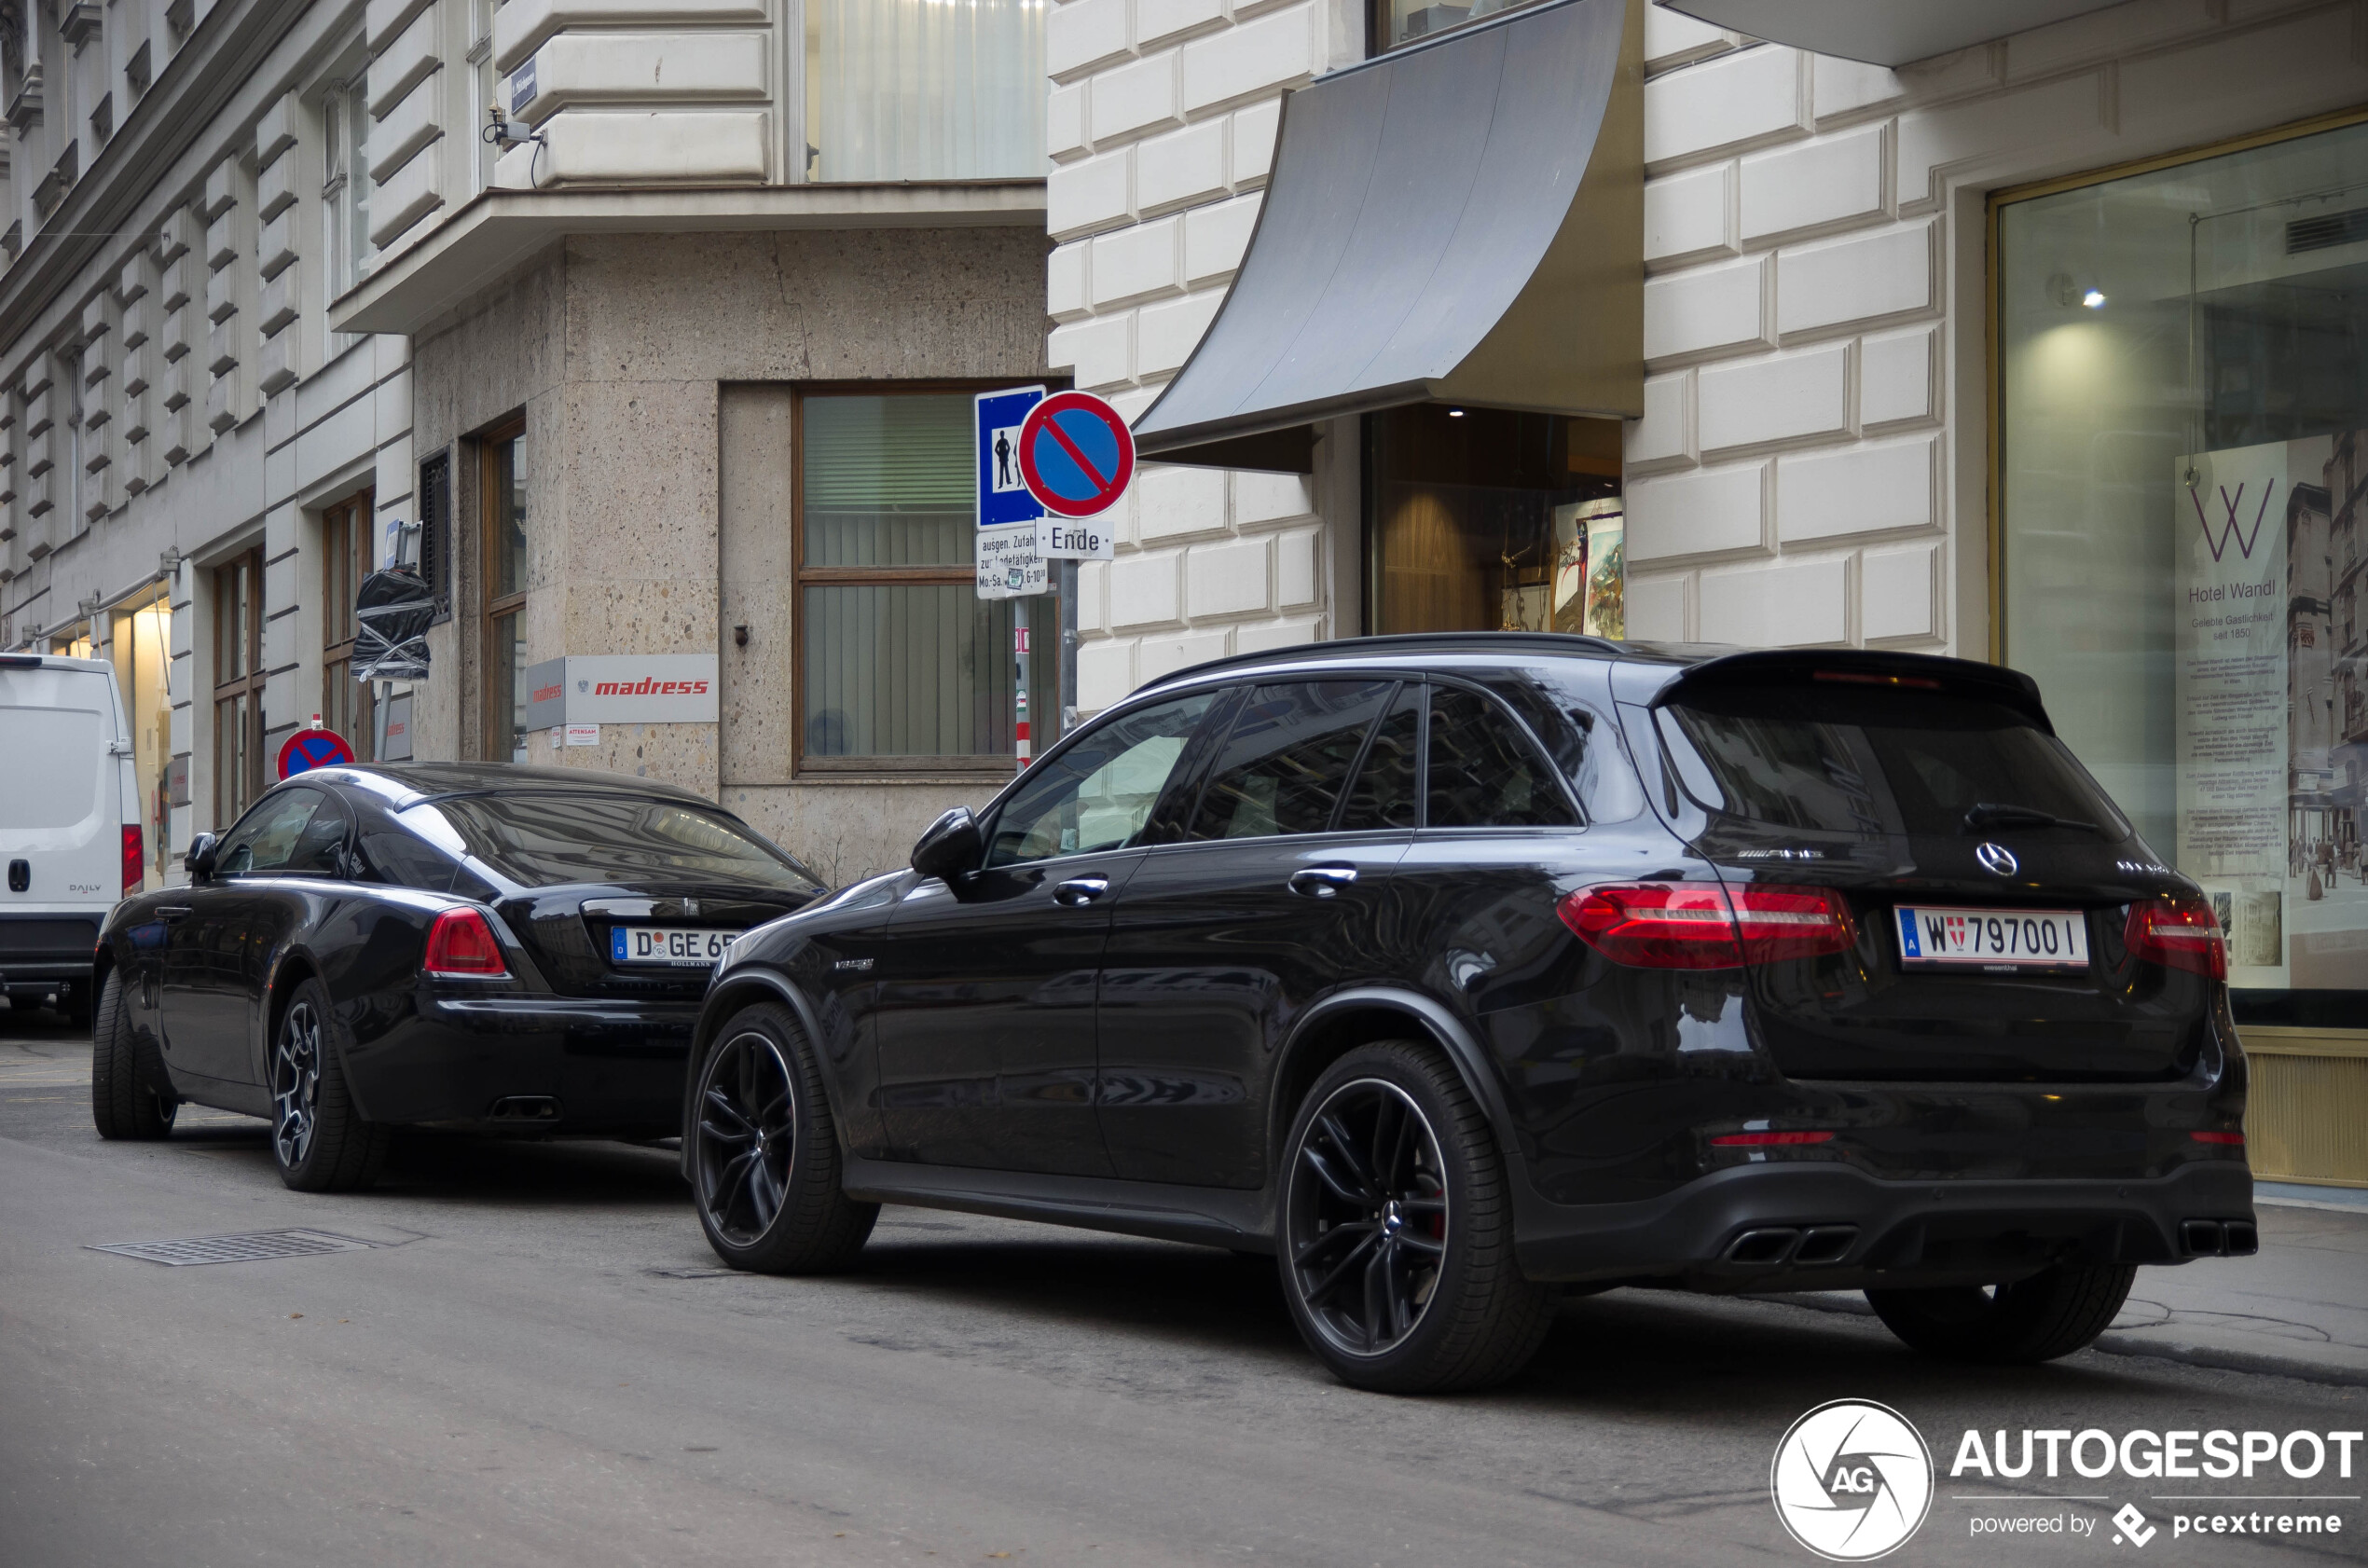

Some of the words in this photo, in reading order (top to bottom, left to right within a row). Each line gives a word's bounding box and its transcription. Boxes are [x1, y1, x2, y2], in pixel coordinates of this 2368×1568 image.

[2190, 478, 2275, 562] W
[983, 539, 1010, 553] ausgen.
[1013, 534, 1036, 548] Zufah
[1052, 527, 1099, 551] Ende
[2189, 585, 2225, 603] Hotel
[2230, 579, 2276, 599] Wandl
[2192, 615, 2223, 627] Gelebte
[2226, 612, 2274, 626] Gastlichkeit
[2213, 630, 2228, 640] seit
[2230, 628, 2251, 639] 1850
[532, 681, 562, 704] madress
[595, 677, 709, 695] madress
[70, 884, 103, 892] DAILY
[617, 946, 624, 955] D
[636, 932, 653, 956] D
[669, 933, 702, 957] GE
[1907, 939, 1917, 951] A
[1924, 915, 1946, 952] W
